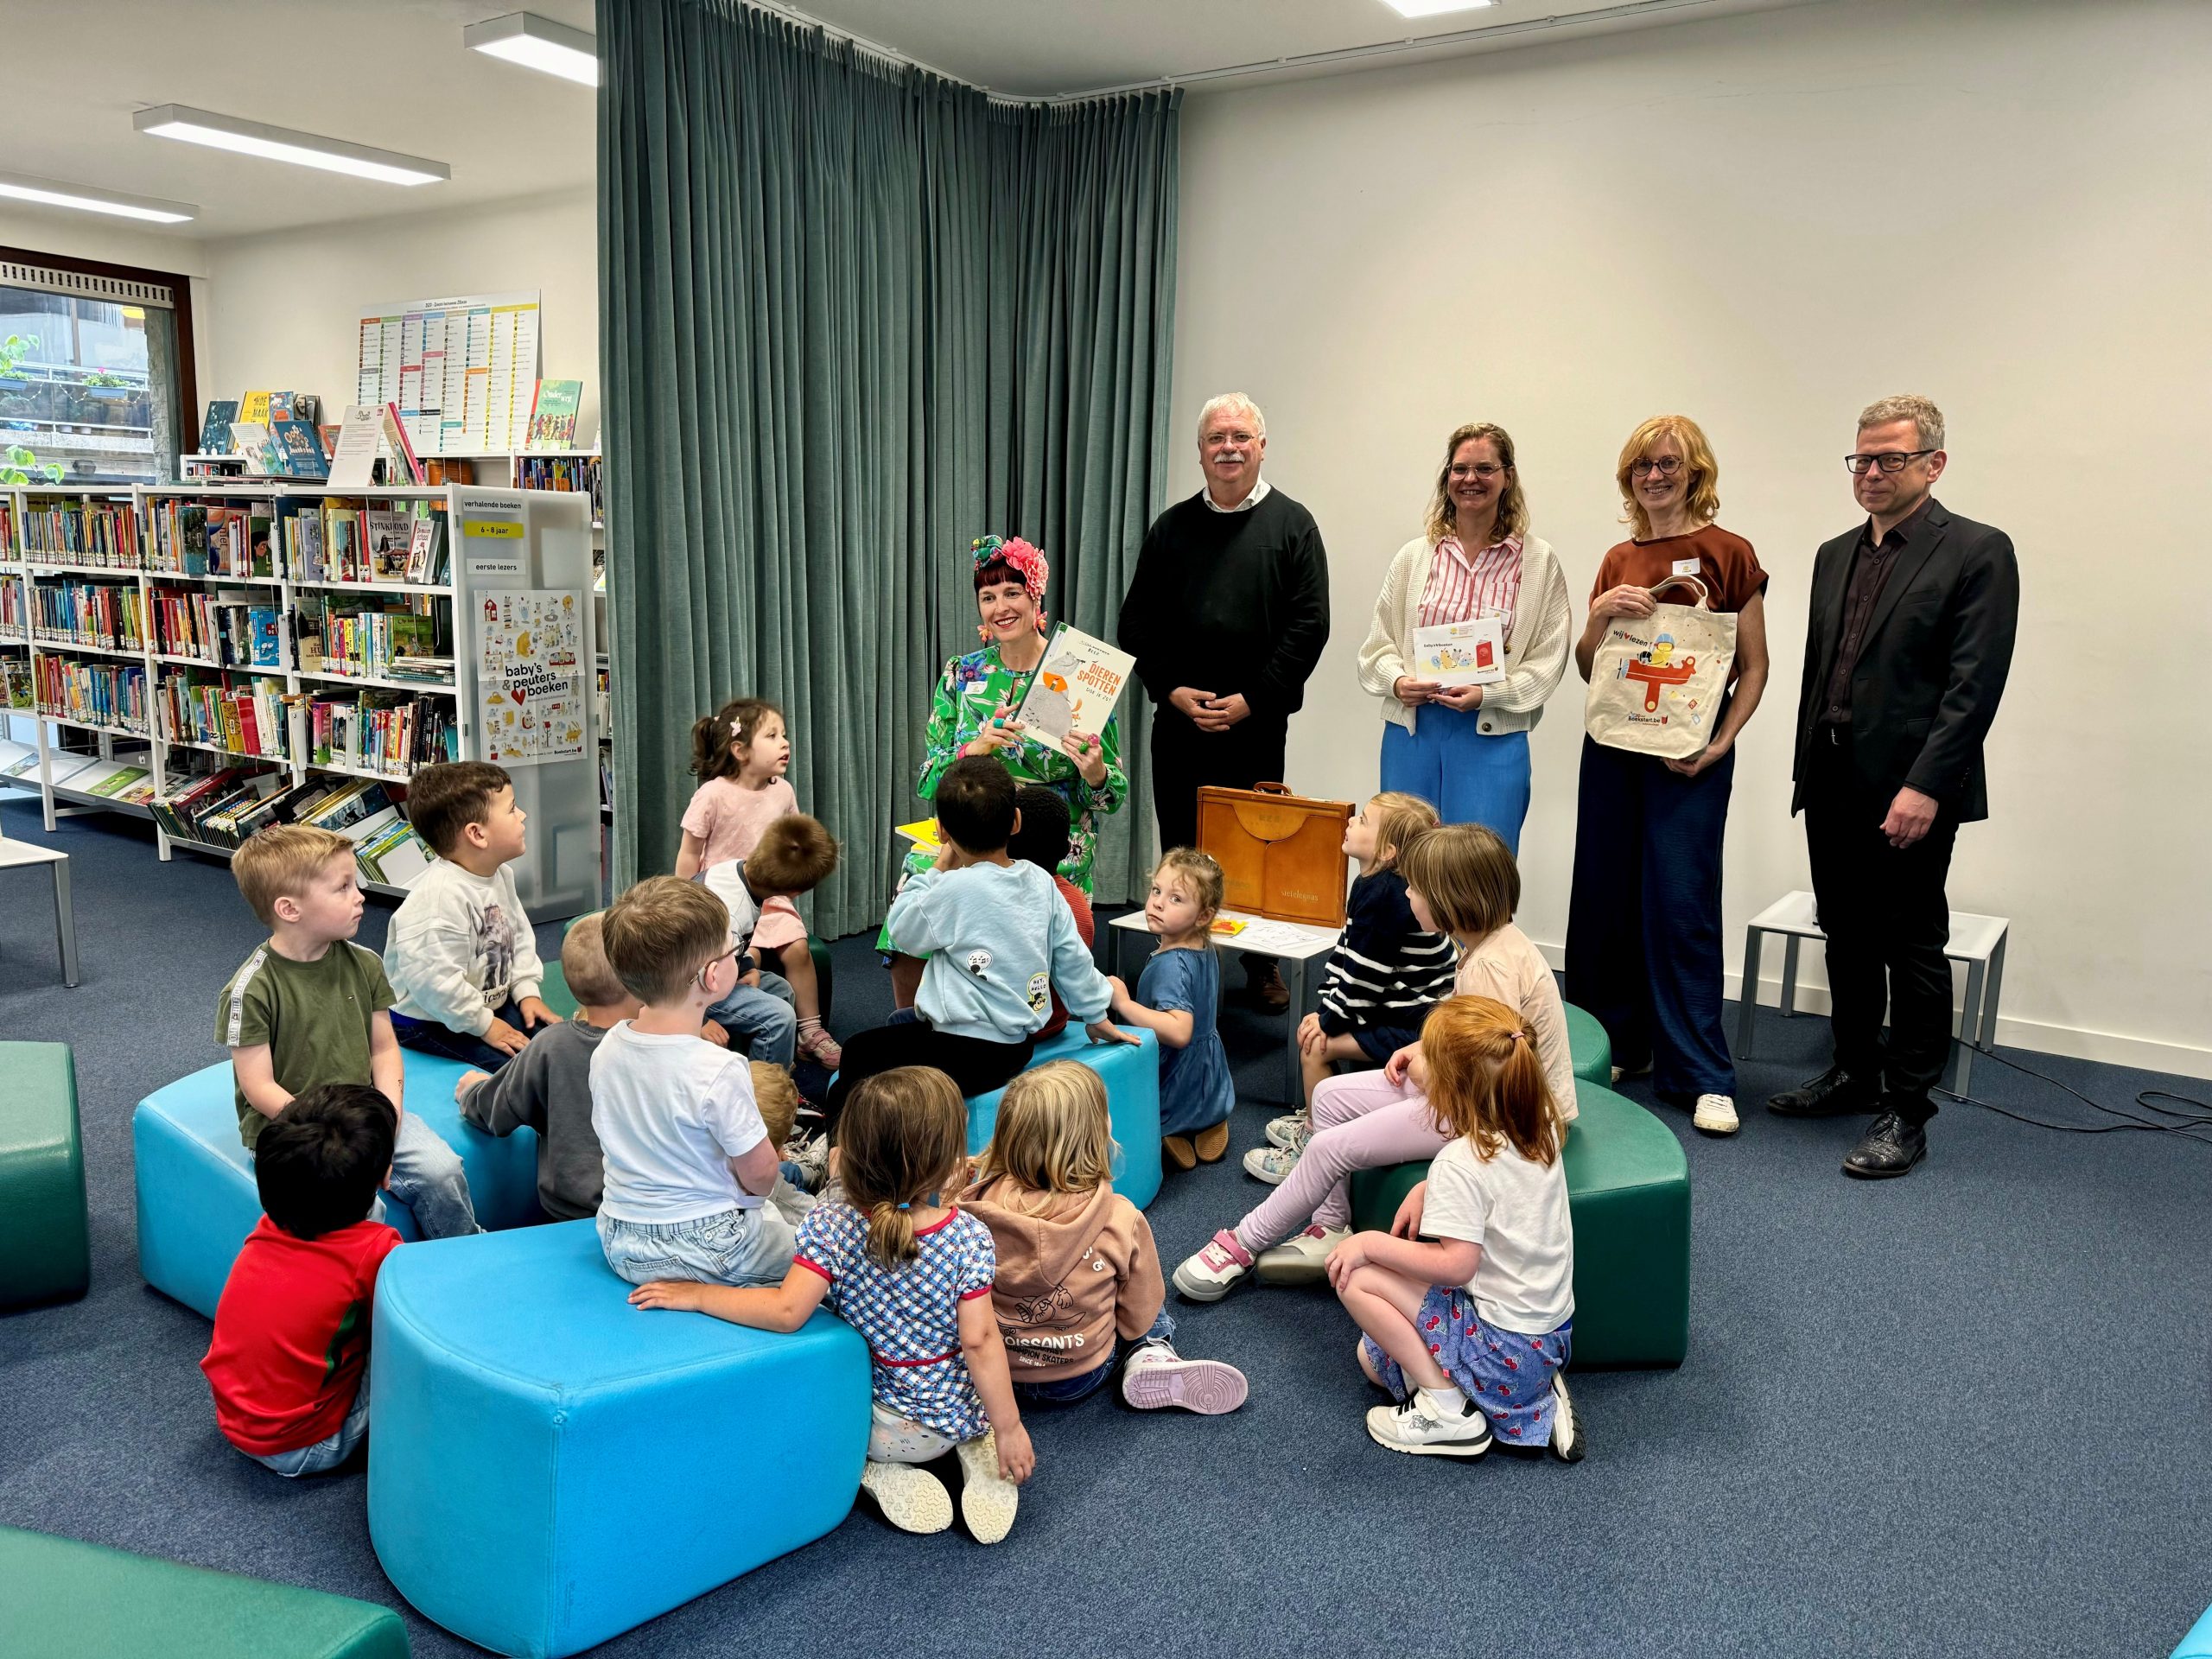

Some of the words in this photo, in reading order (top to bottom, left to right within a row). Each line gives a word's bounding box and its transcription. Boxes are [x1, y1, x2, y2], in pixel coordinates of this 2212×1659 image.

[1613, 630, 1624, 639] wij
[1629, 635, 1649, 647] lezen
[505, 663, 543, 677] baby's
[1089, 664, 1121, 685] DIEREN
[502, 679, 511, 690] &
[513, 672, 556, 692] peuters
[527, 681, 569, 696] boeken
[1077, 670, 1116, 696] SPOTTEN
[228, 1020, 239, 1046] TOMMY
[1003, 1333, 1084, 1349] OISSANTS
[1019, 1356, 1033, 1365] SINCE
